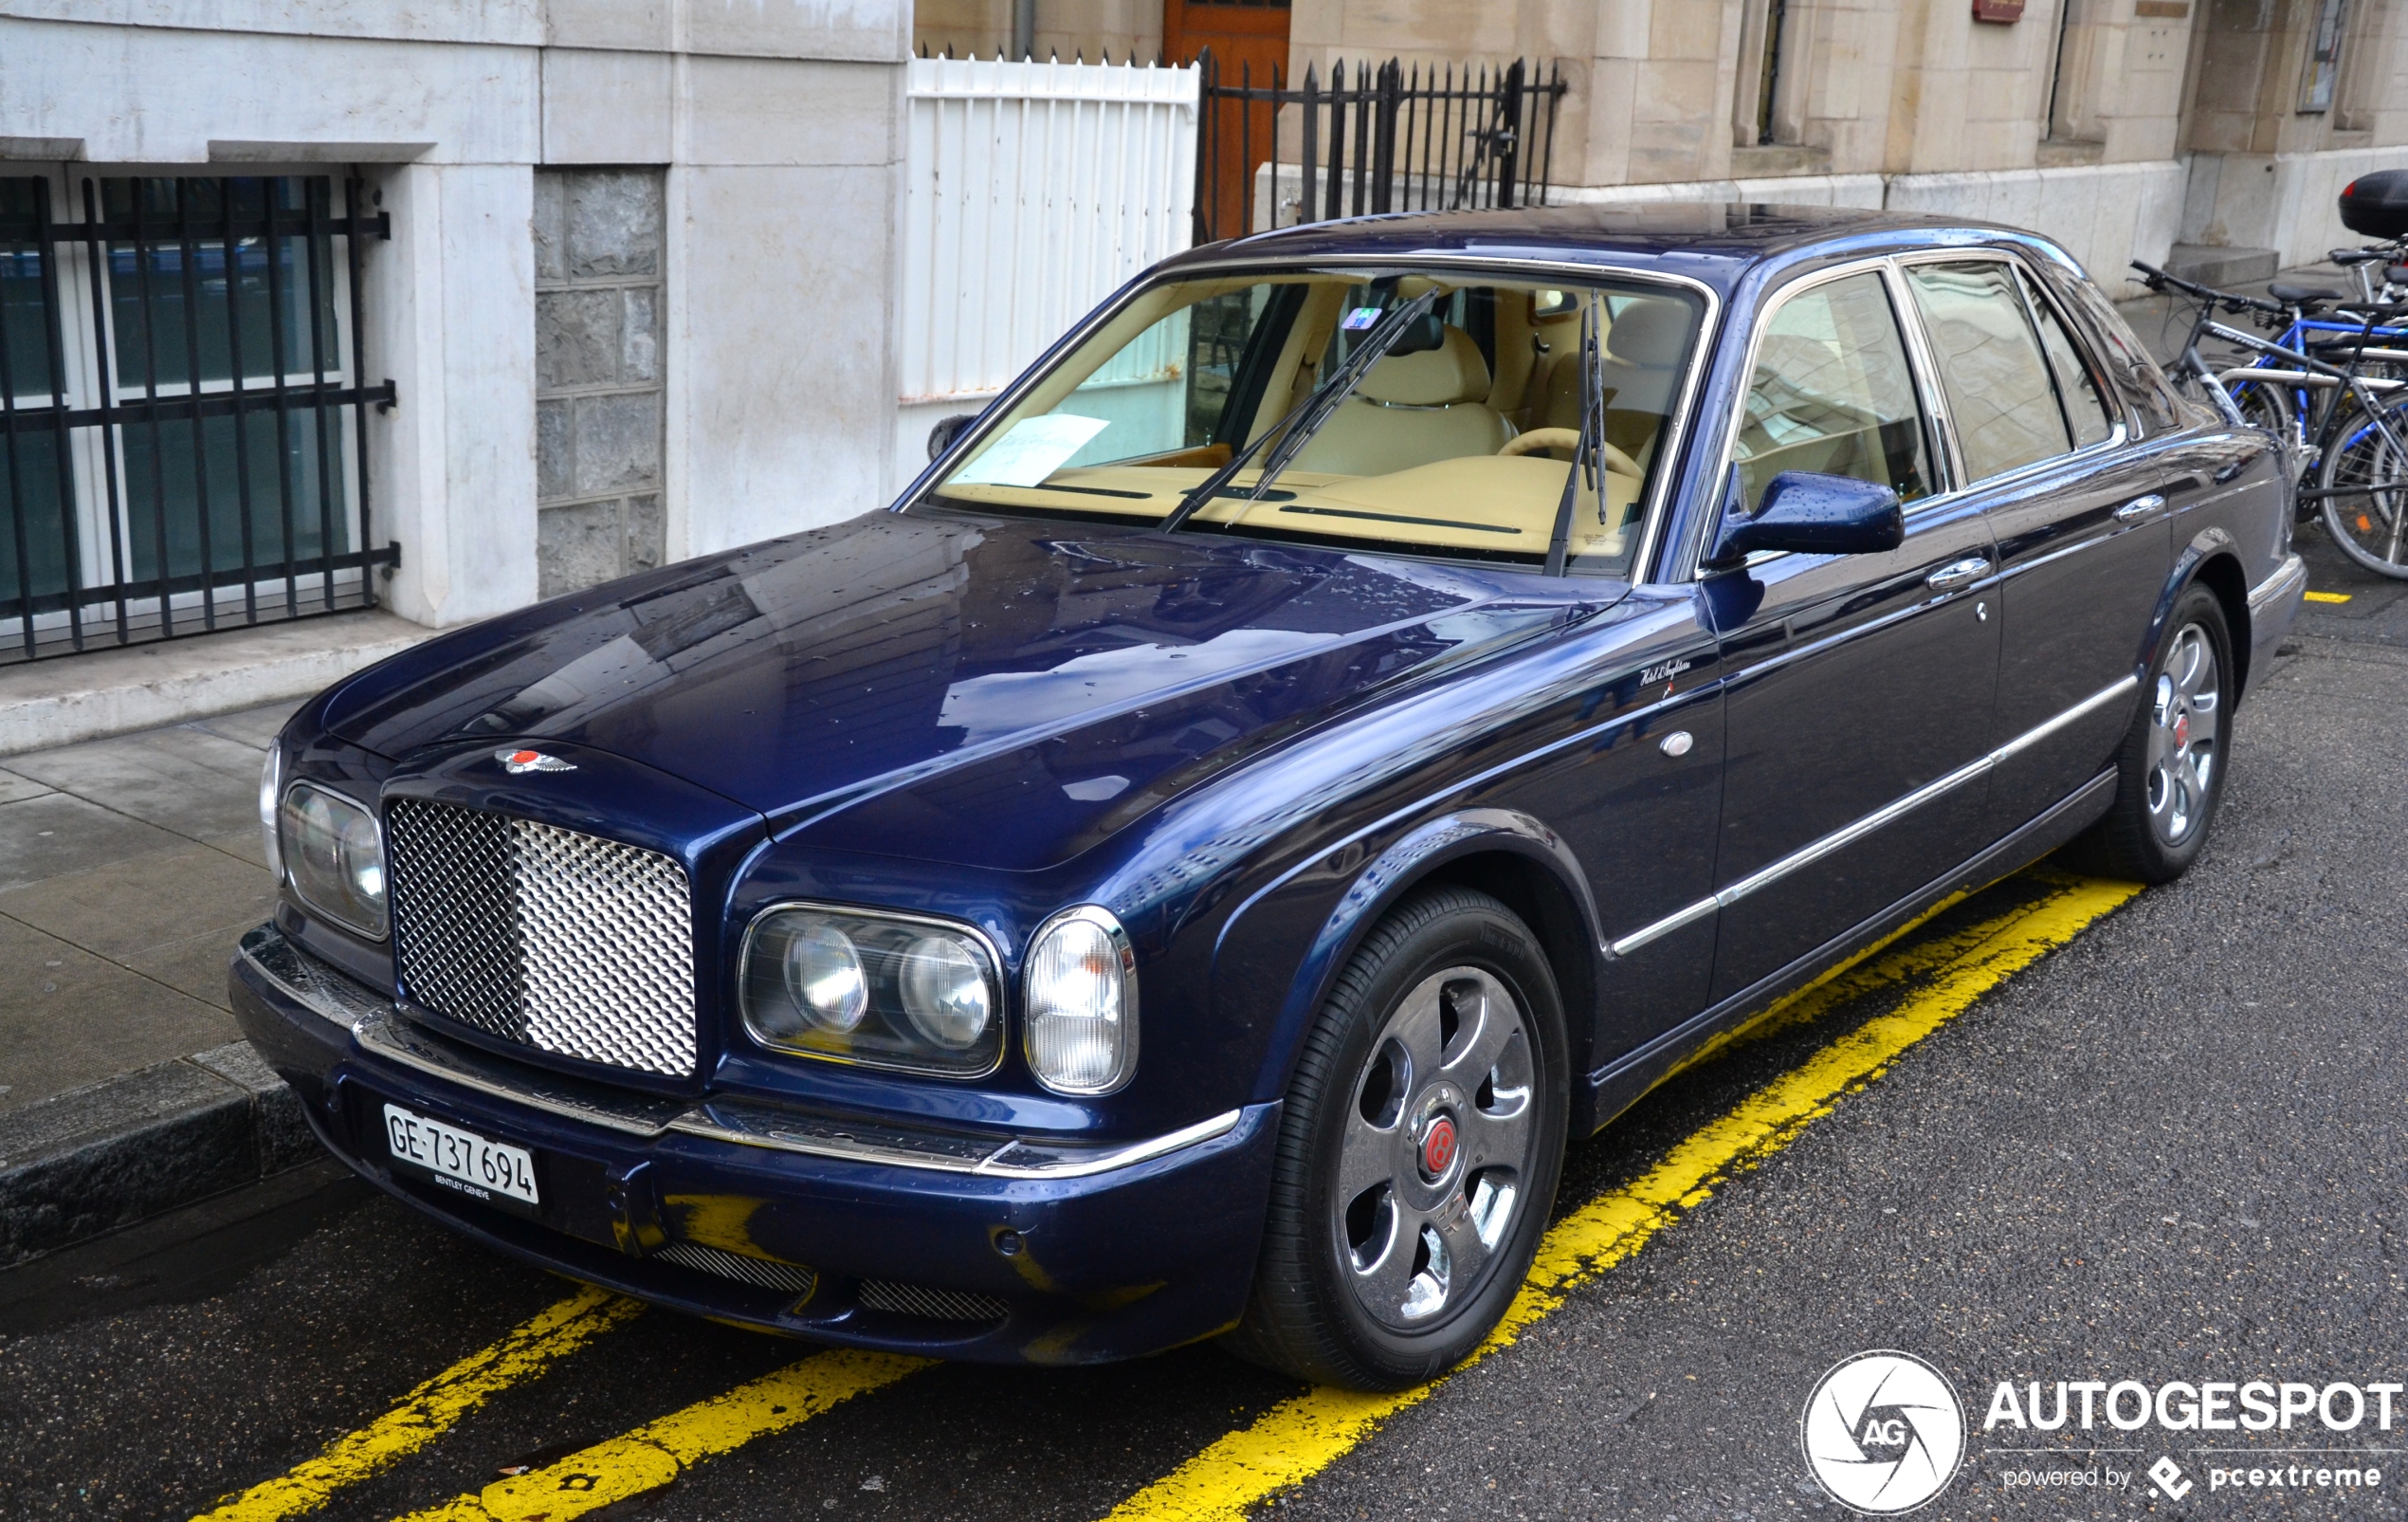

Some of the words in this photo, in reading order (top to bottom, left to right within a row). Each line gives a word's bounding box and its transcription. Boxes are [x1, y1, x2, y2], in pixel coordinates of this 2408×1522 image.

[434, 1174, 463, 1191] BENTLEY
[464, 1184, 490, 1201] GENEVE
[482, 1146, 533, 1197] 694
